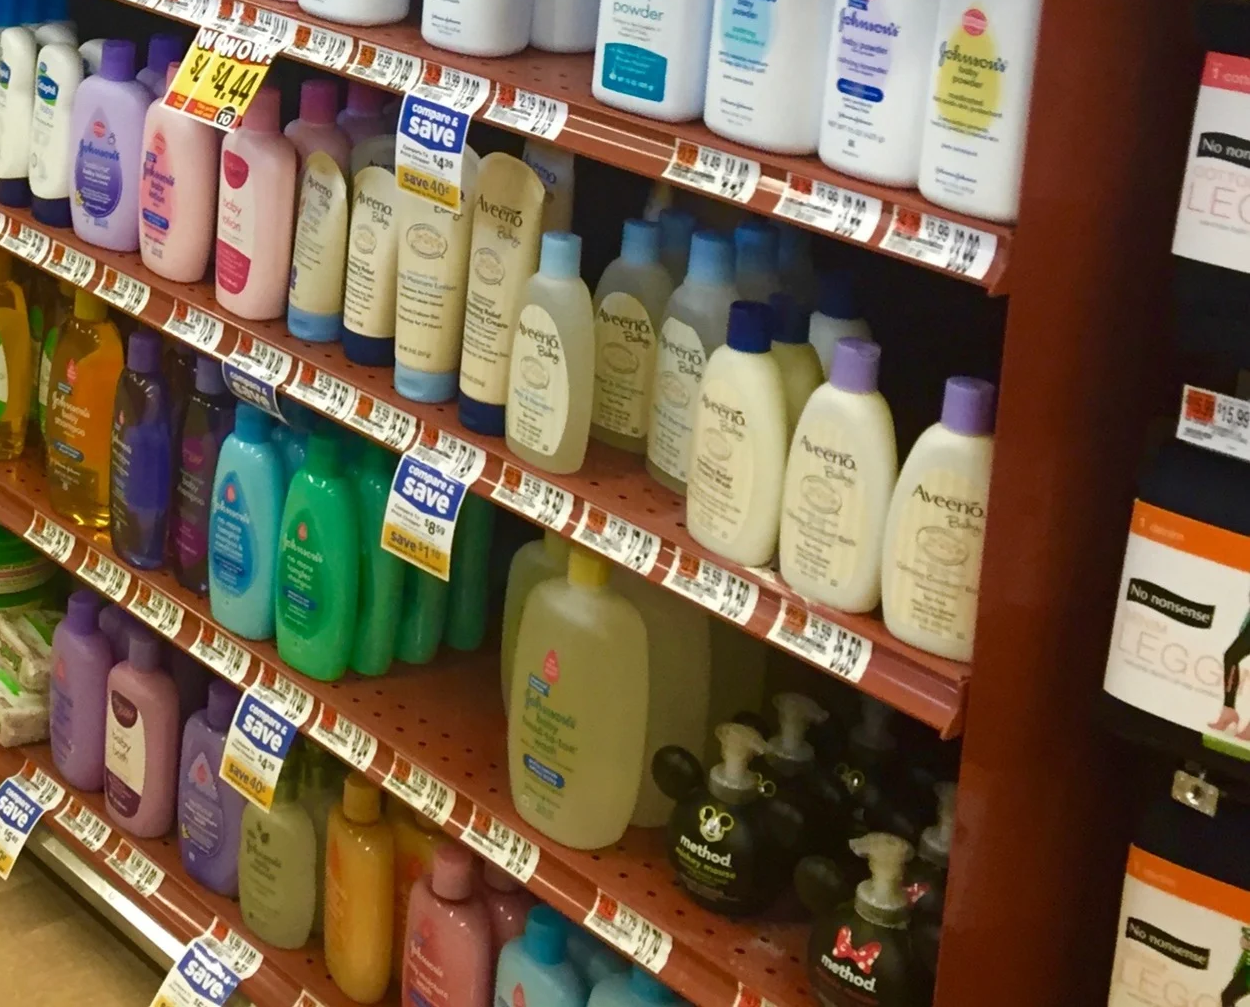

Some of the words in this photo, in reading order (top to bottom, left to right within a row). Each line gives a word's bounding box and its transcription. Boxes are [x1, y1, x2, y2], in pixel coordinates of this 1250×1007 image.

[613, 0, 663, 23] powder
[838, 9, 901, 39] Johnson's
[939, 41, 1007, 74] Johnson's
[211, 61, 259, 106] $4.44
[952, 75, 983, 90] powder
[957, 65, 978, 79] baby
[218, 114, 231, 126] 10
[412, 104, 450, 125] compare
[451, 117, 458, 127] &
[408, 116, 455, 147] save
[79, 139, 119, 162] Johnson's
[1202, 138, 1222, 154] No
[404, 173, 429, 187] save
[430, 181, 450, 196] 40¢
[356, 190, 392, 216] Aveeno
[476, 194, 523, 228] Aveeno
[600, 309, 650, 334] Aveeno
[519, 322, 559, 350] Aveeno
[623, 330, 650, 348] Baby
[537, 345, 559, 364] Baby
[679, 360, 703, 384] Baby
[702, 393, 746, 428] Aveeno
[800, 435, 857, 472] Aveeno
[408, 465, 447, 491] compare
[447, 484, 455, 495] &
[824, 465, 855, 489] Baby
[402, 477, 450, 514] save
[913, 484, 983, 519] Aveeno
[947, 514, 982, 535] Baby
[391, 532, 416, 552] save
[1130, 584, 1148, 601] No
[1151, 593, 1210, 624] nonsense
[249, 704, 281, 730] compare
[281, 726, 288, 735] &
[524, 688, 577, 731] Johnson's
[112, 731, 131, 751] baby
[242, 714, 282, 752] save
[229, 763, 249, 782] save
[5, 788, 30, 810] compare
[680, 834, 731, 867] method
[703, 861, 736, 881] mouse
[1129, 922, 1147, 940] No
[1149, 933, 1207, 966] nonsense
[184, 959, 224, 999] save
[821, 953, 876, 993] method
